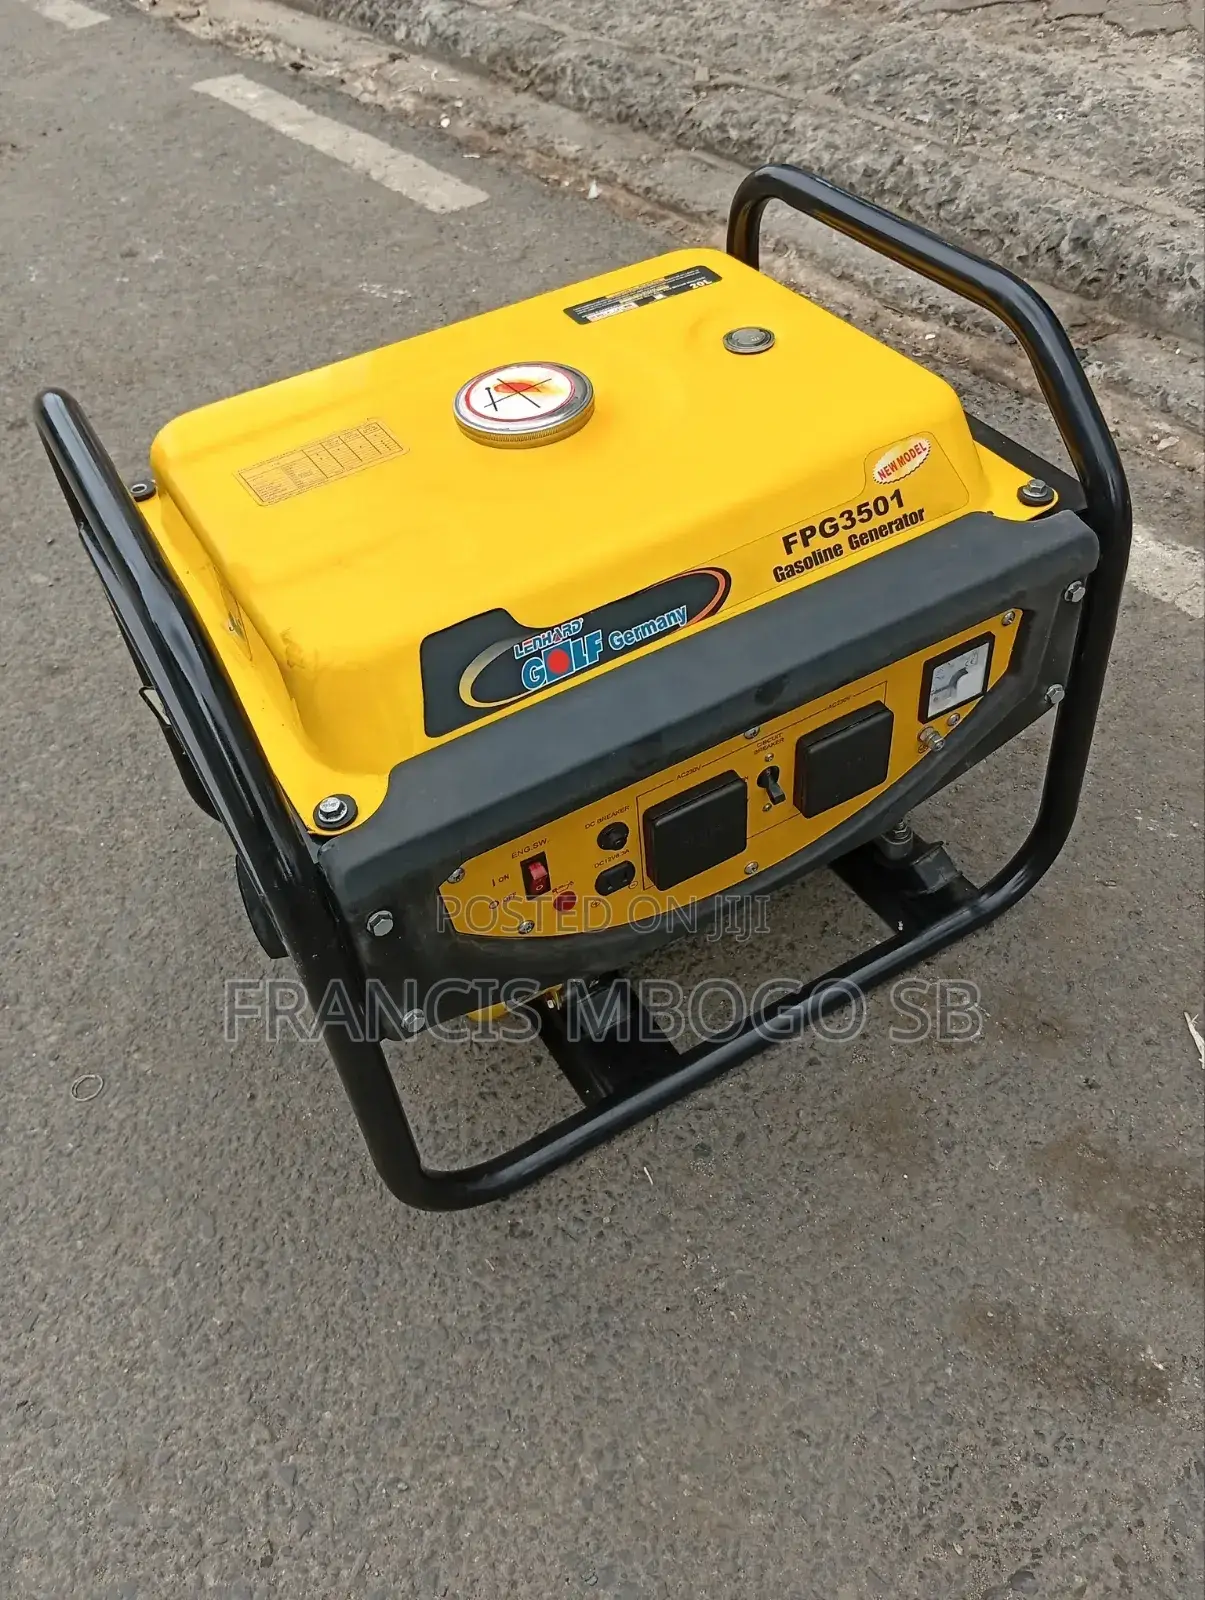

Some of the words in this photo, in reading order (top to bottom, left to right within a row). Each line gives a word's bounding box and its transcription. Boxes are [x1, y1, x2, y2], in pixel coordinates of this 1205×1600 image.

[877, 462, 898, 481] NEW
[898, 441, 928, 468] MODEL
[772, 543, 844, 583] Gasoline
[847, 507, 926, 551] Generator
[781, 488, 905, 556] FPG3501
[521, 629, 604, 690] GOLF
[608, 604, 688, 651] Germany
